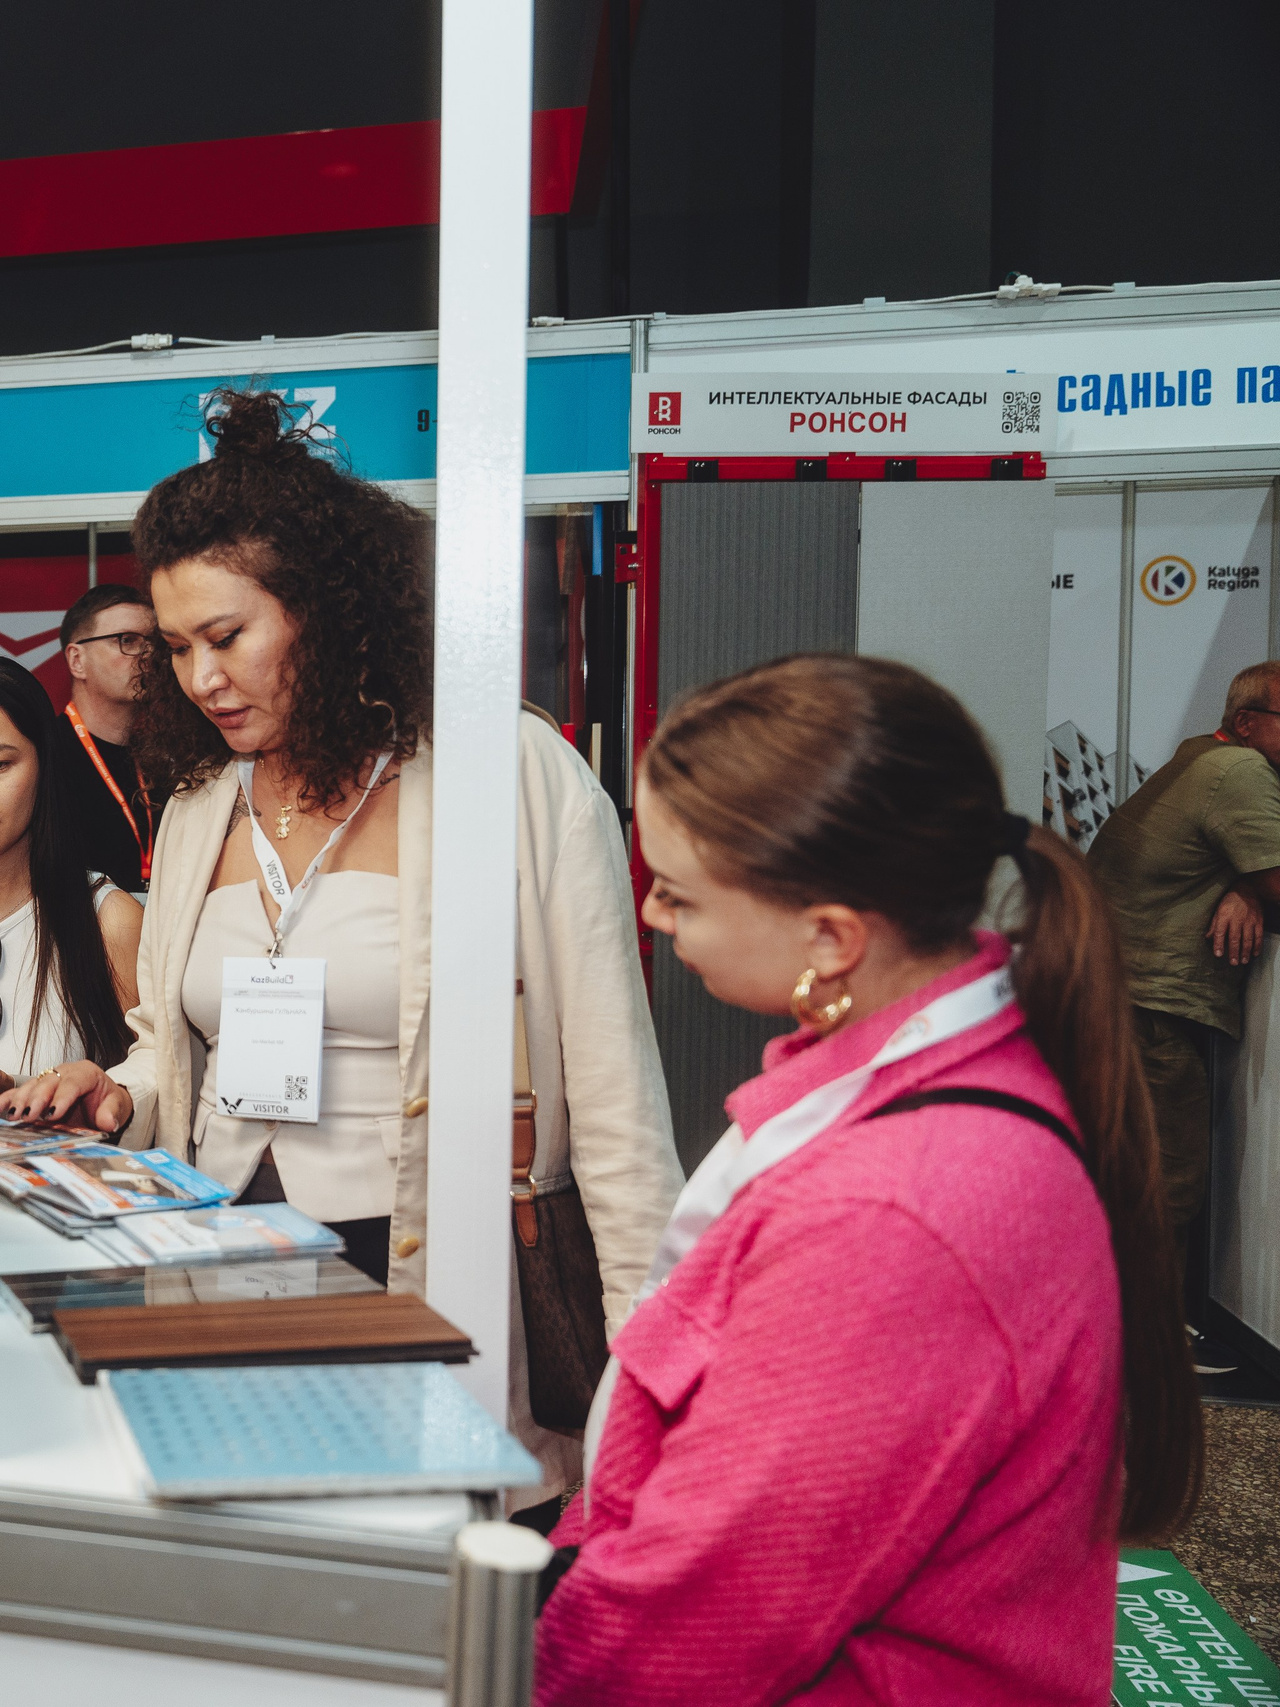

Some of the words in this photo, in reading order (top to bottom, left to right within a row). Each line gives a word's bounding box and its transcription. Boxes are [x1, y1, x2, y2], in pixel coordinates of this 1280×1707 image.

[709, 391, 902, 405] ИНТЕЛЛЕКТУАЛЬНЫЕ
[907, 390, 988, 406] ФАСАДЫ
[789, 411, 907, 434] РОНСОН
[647, 427, 681, 435] РОНСОН
[1207, 565, 1270, 581] Kaluga
[1207, 577, 1270, 593] Region
[266, 859, 286, 896] VISITOR
[250, 975, 286, 984] KazBuild
[252, 1103, 290, 1115] VISITOR
[1113, 1644, 1174, 1695] FIRE
